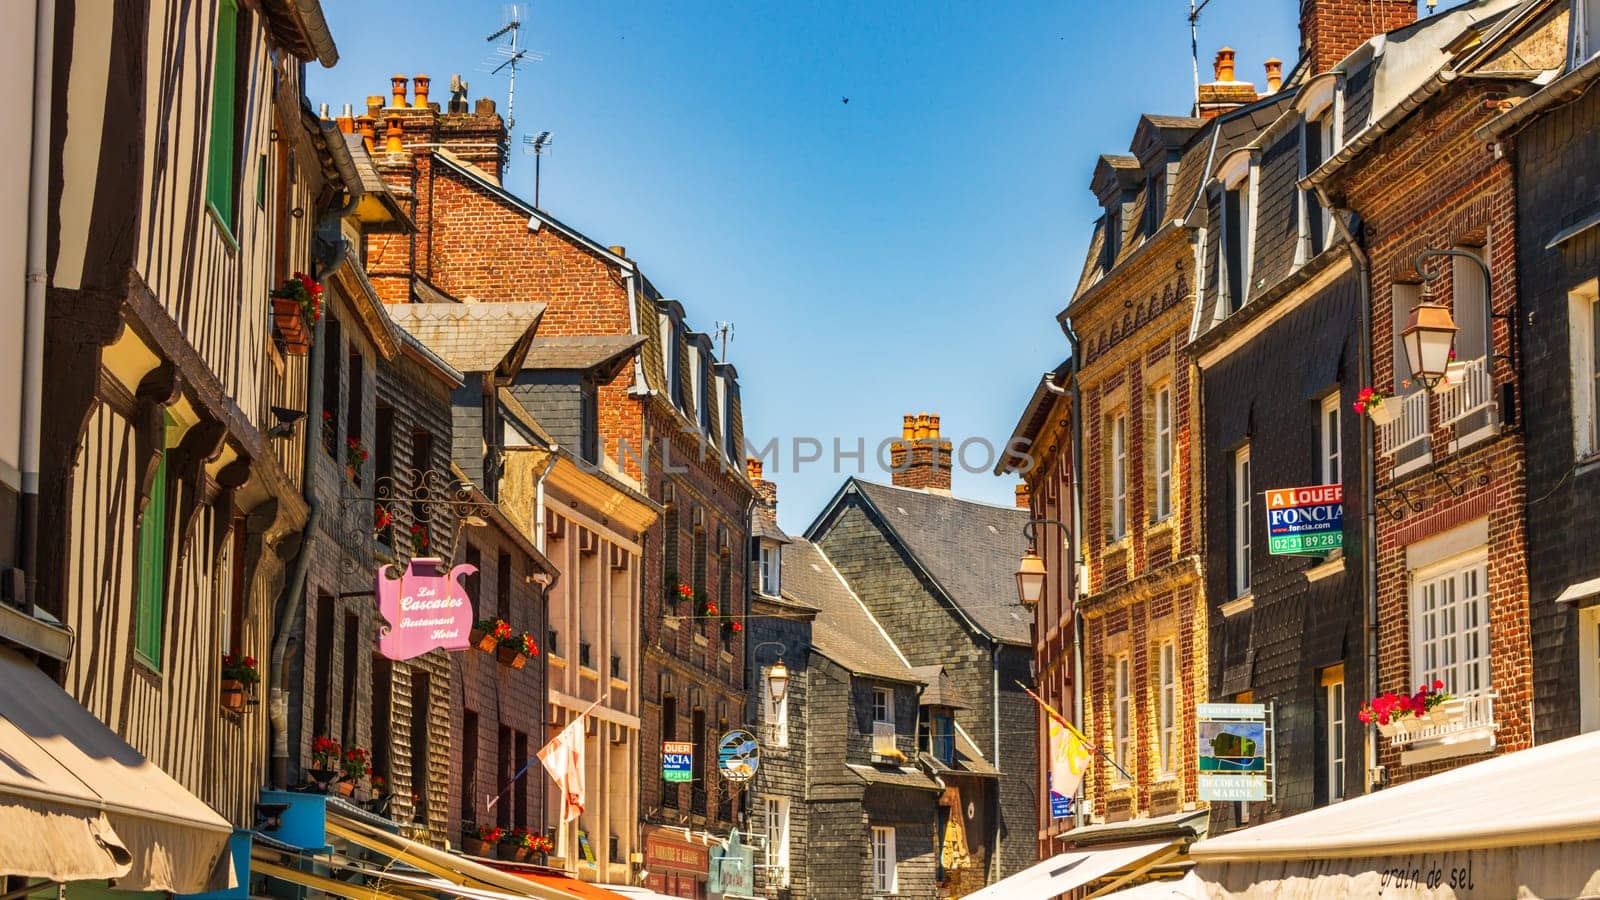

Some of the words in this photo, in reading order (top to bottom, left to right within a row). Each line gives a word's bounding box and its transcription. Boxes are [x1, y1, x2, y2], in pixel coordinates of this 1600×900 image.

[1271, 493, 1284, 506] A
[1274, 539, 1288, 549] 02
[1290, 537, 1302, 548] 31
[1305, 536, 1318, 546] 89
[1321, 534, 1334, 545] 28
[416, 586, 435, 597] Les
[400, 596, 463, 611] Cascades
[400, 616, 455, 628] Restaurant
[1378, 861, 1419, 896] grain
[1427, 859, 1442, 890] de
[1449, 859, 1474, 890] sel
